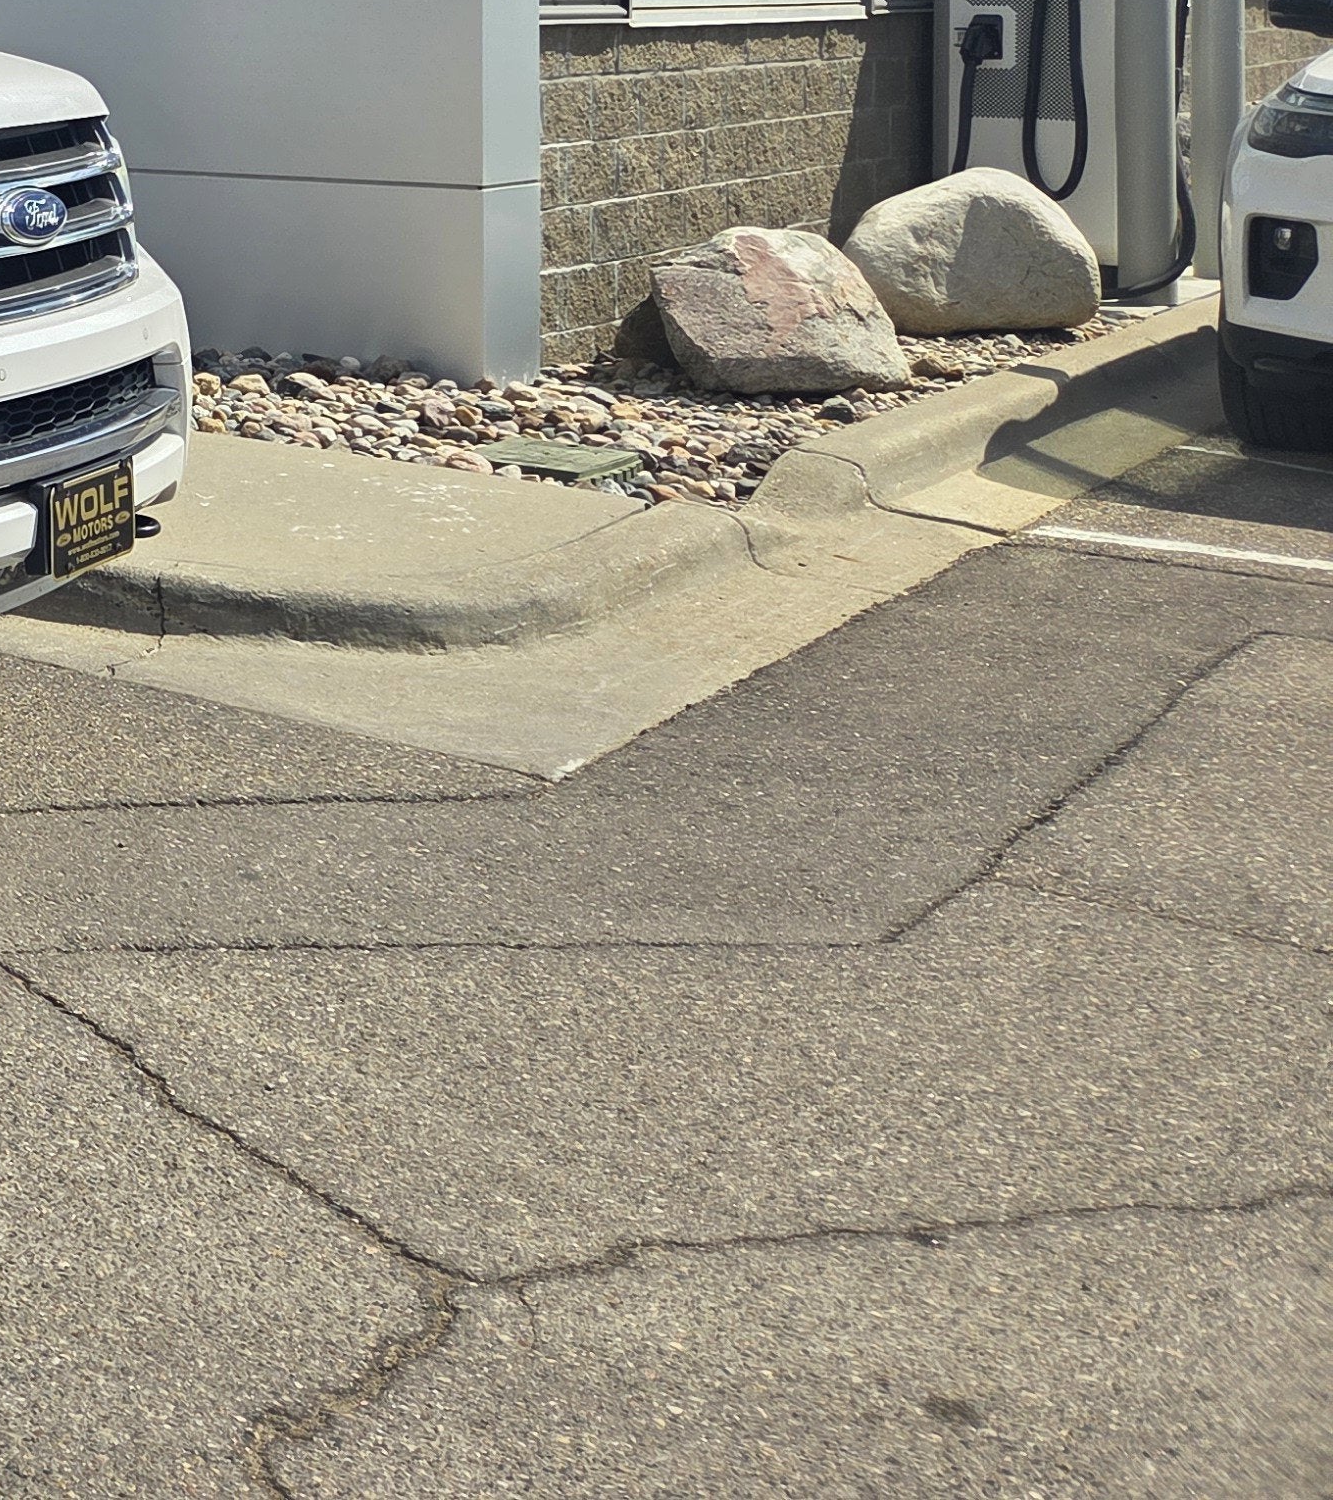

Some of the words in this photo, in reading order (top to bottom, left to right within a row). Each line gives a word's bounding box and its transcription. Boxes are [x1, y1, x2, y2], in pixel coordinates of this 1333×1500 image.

[24, 199, 60, 230] Ford
[54, 475, 129, 531] WOLF
[72, 514, 114, 543] MOTORS
